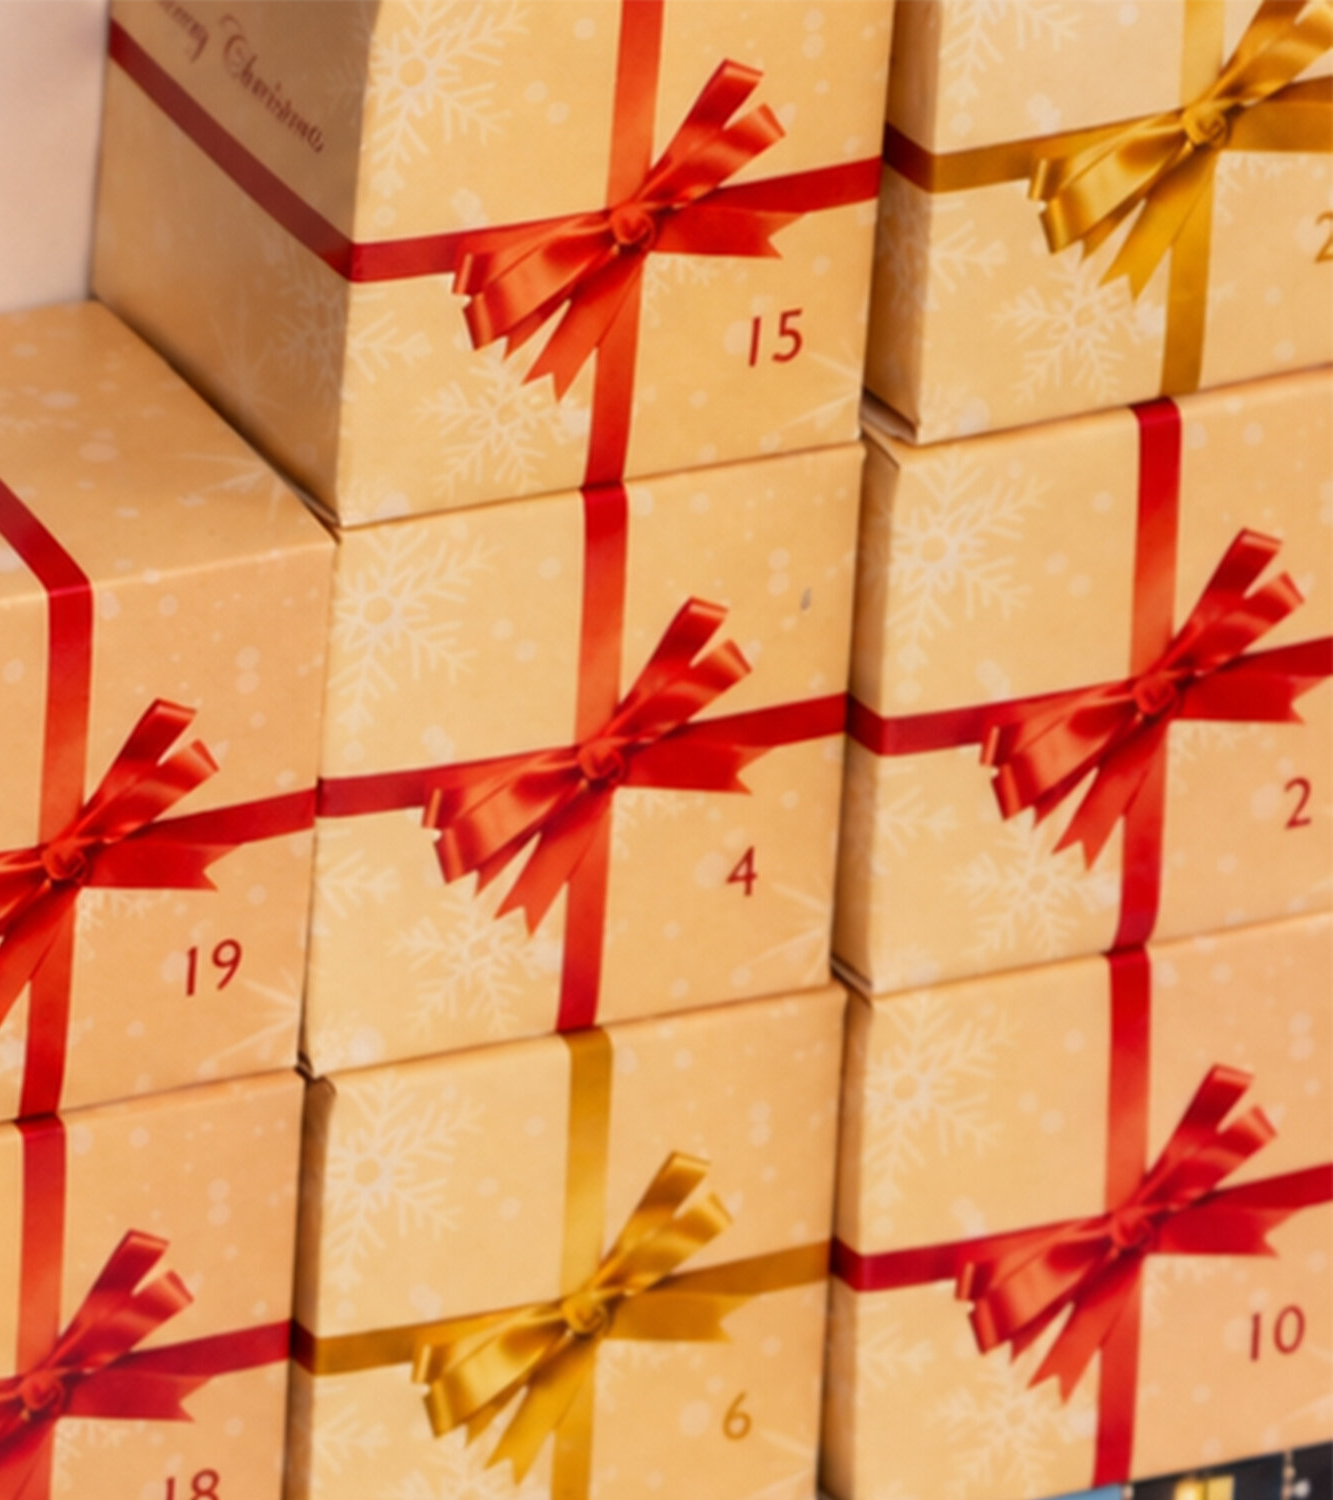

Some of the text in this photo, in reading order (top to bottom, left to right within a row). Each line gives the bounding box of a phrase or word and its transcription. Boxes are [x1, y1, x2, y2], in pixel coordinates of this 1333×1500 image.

[748, 308, 804, 367] 15
[1283, 778, 1312, 830] 2
[725, 845, 758, 897] 4
[183, 938, 242, 998] 19
[1248, 1304, 1306, 1362] 10
[721, 1390, 752, 1441] 6
